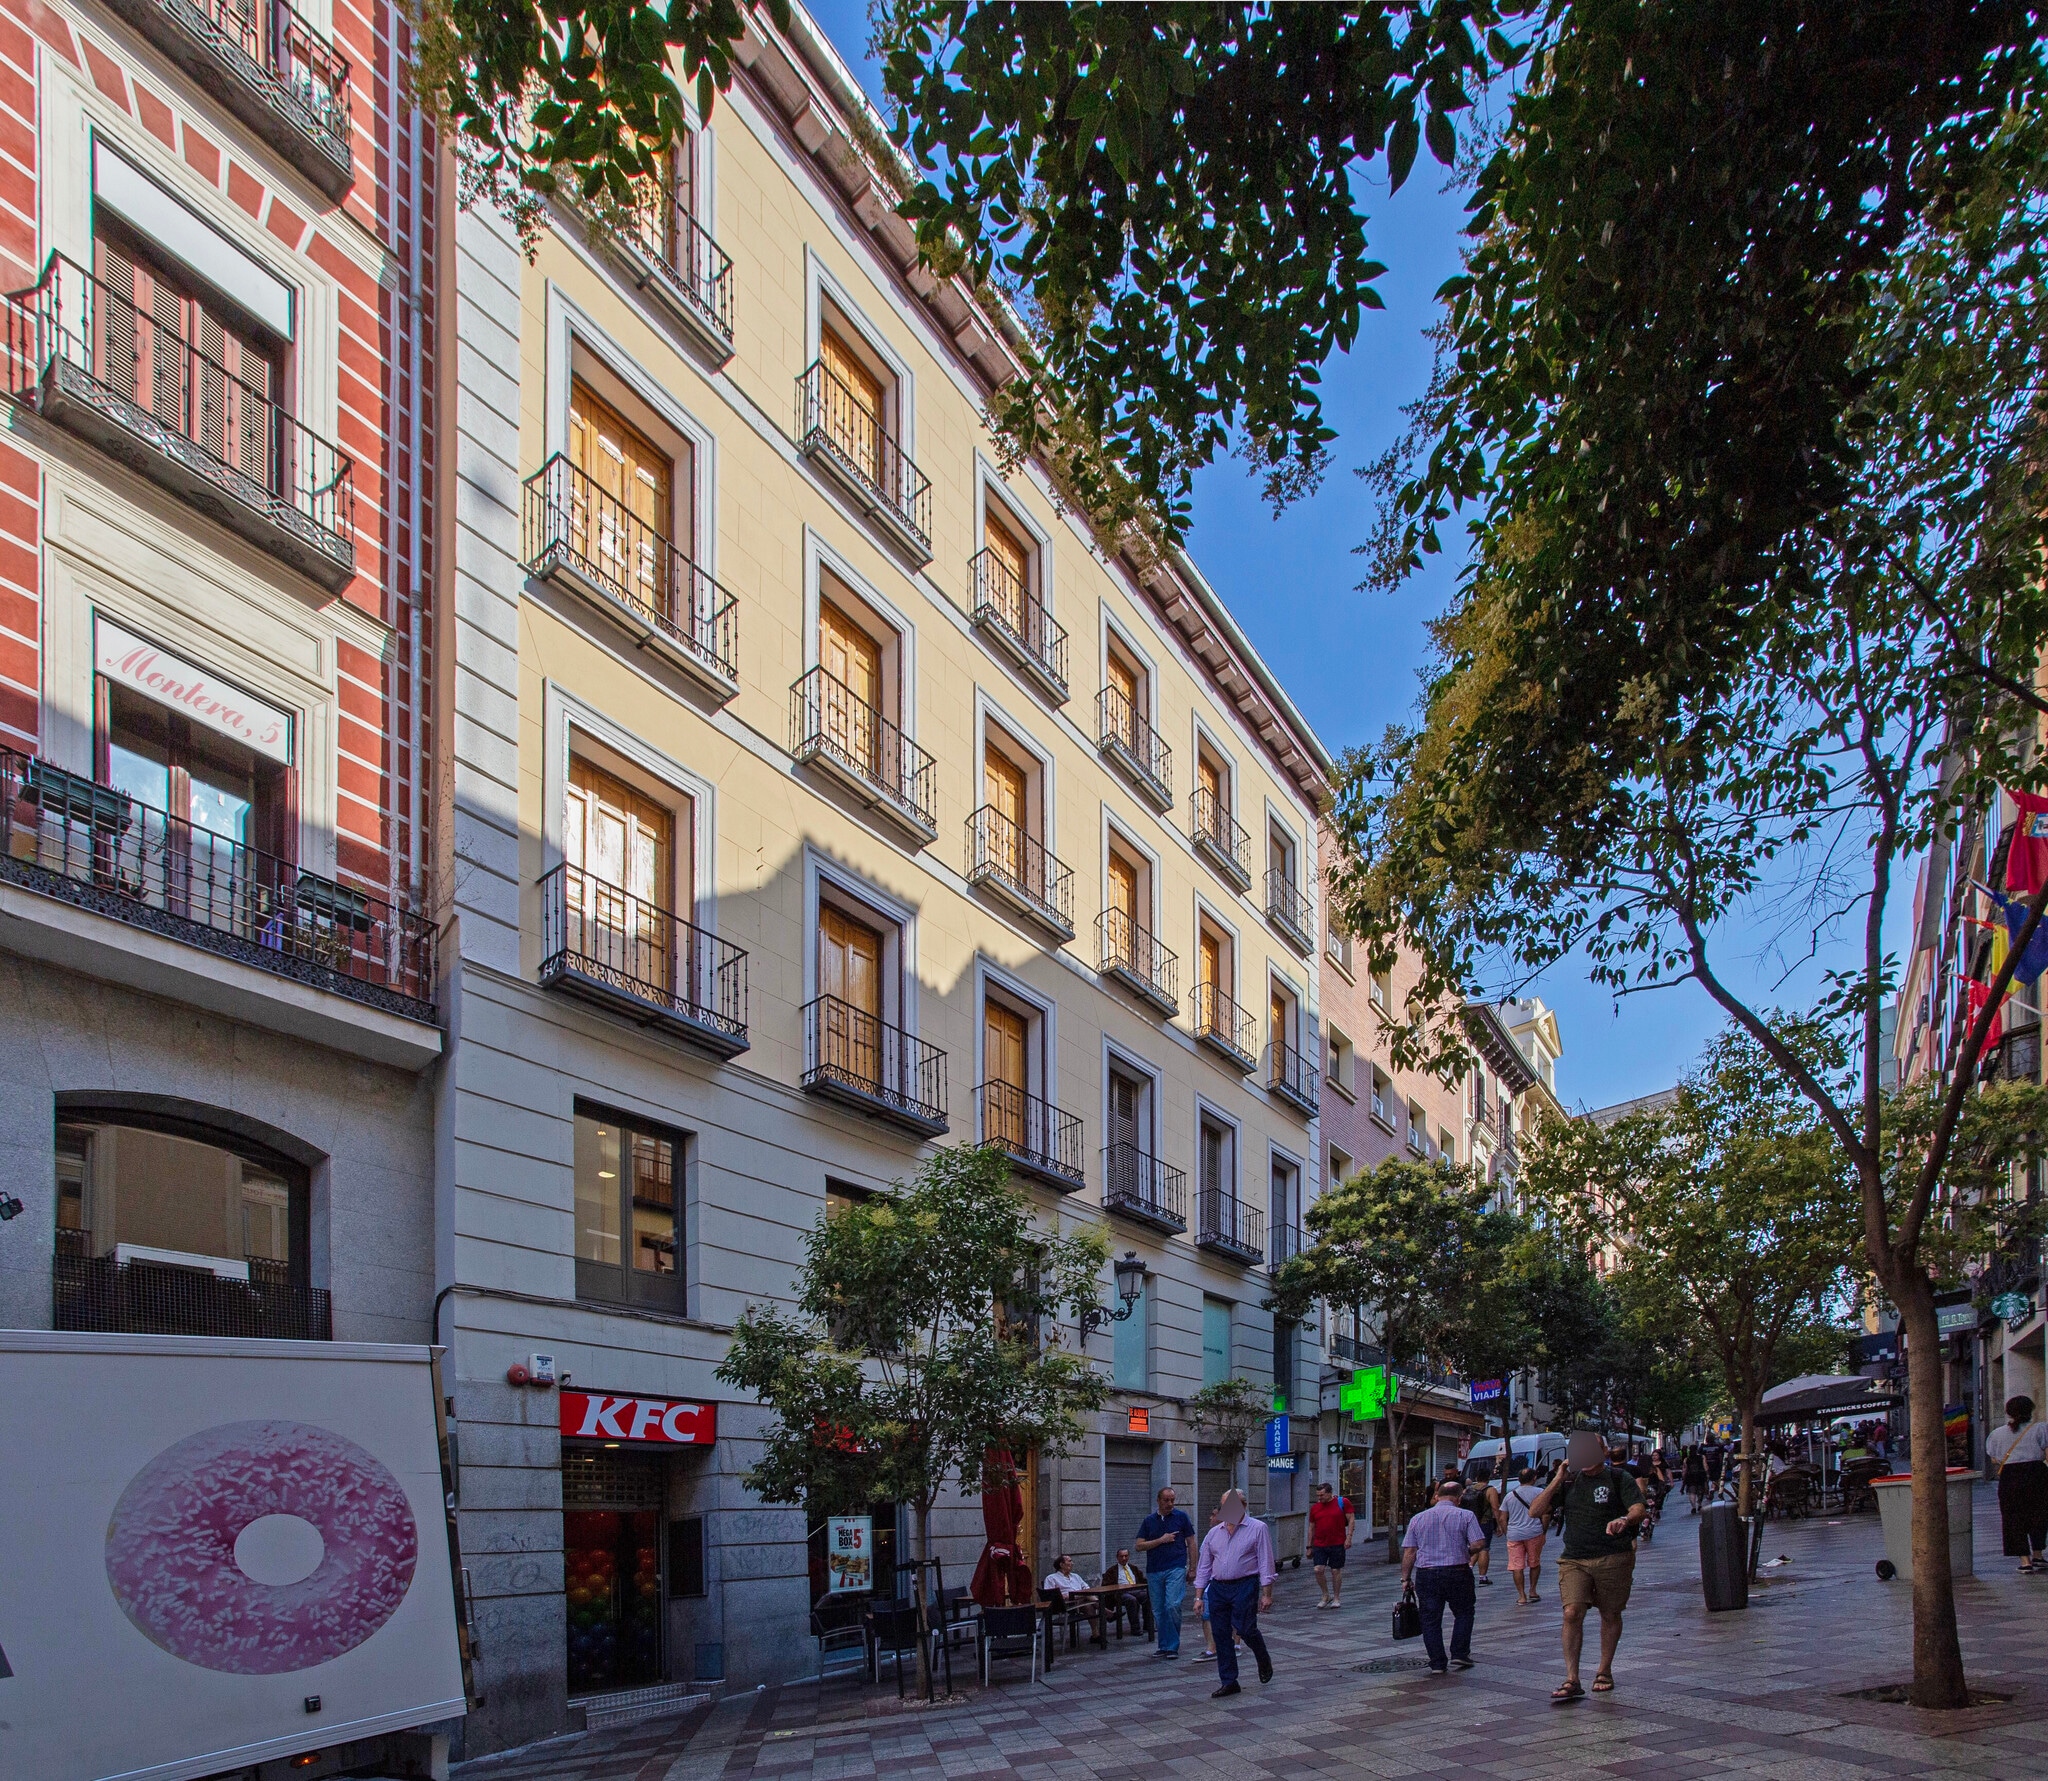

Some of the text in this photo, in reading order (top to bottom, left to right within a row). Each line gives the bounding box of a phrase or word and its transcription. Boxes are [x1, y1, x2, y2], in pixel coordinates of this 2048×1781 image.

[105, 645, 283, 744] Montera, 5
[1816, 1400, 1891, 1415] STARBUCKS COFFEE
[576, 1395, 700, 1442] KFC
[1268, 1457, 1295, 1469] HANGE
[838, 1528, 853, 1537] MEGA
[838, 1536, 853, 1547] BOX
